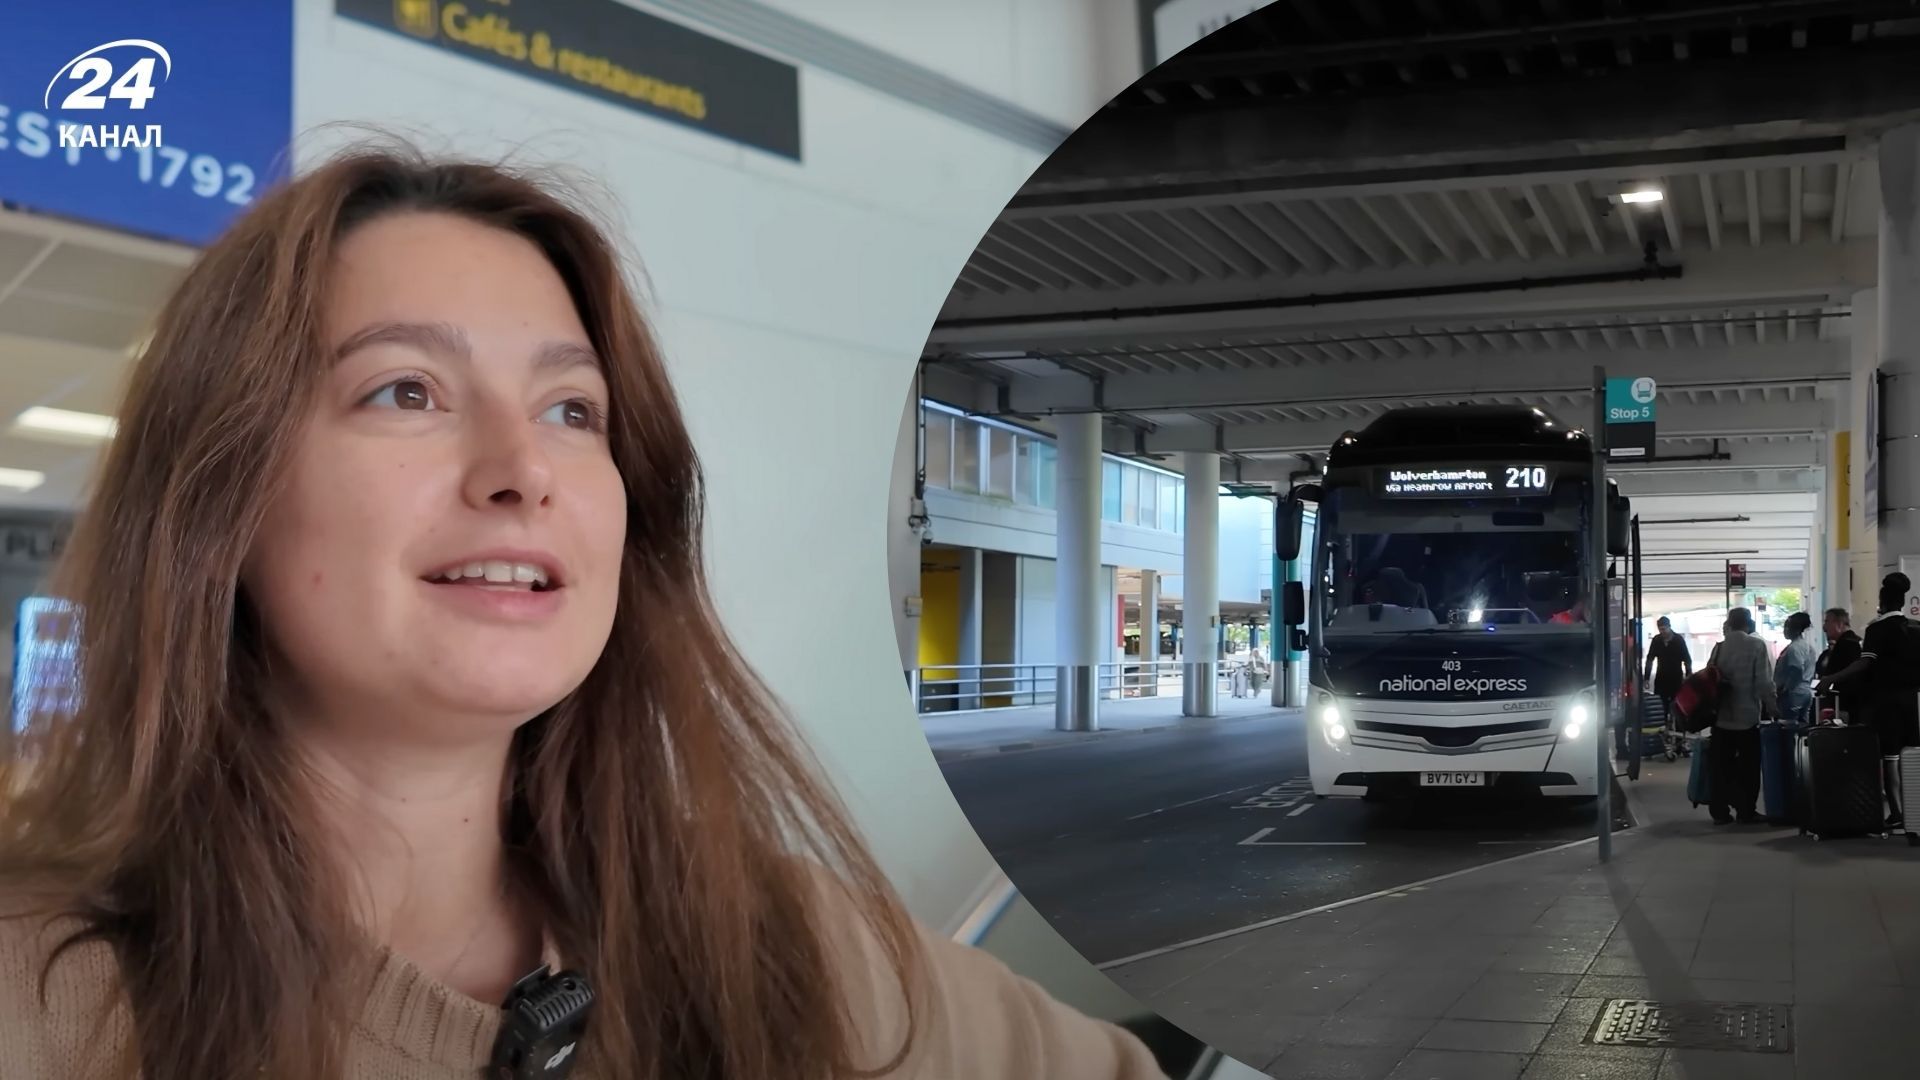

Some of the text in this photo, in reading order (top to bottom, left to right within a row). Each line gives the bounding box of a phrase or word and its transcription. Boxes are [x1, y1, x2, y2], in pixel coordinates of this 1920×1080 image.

[529, 31, 556, 70] &
[557, 48, 707, 120] restaurants
[1610, 406, 1650, 421] Stop 5
[1390, 467, 1546, 488] Wolverhampton 210
[1441, 660, 1462, 671] 403
[1379, 674, 1528, 696] national express
[1502, 700, 1557, 711] CAETAN
[1427, 773, 1477, 784] BV71 GYJ
